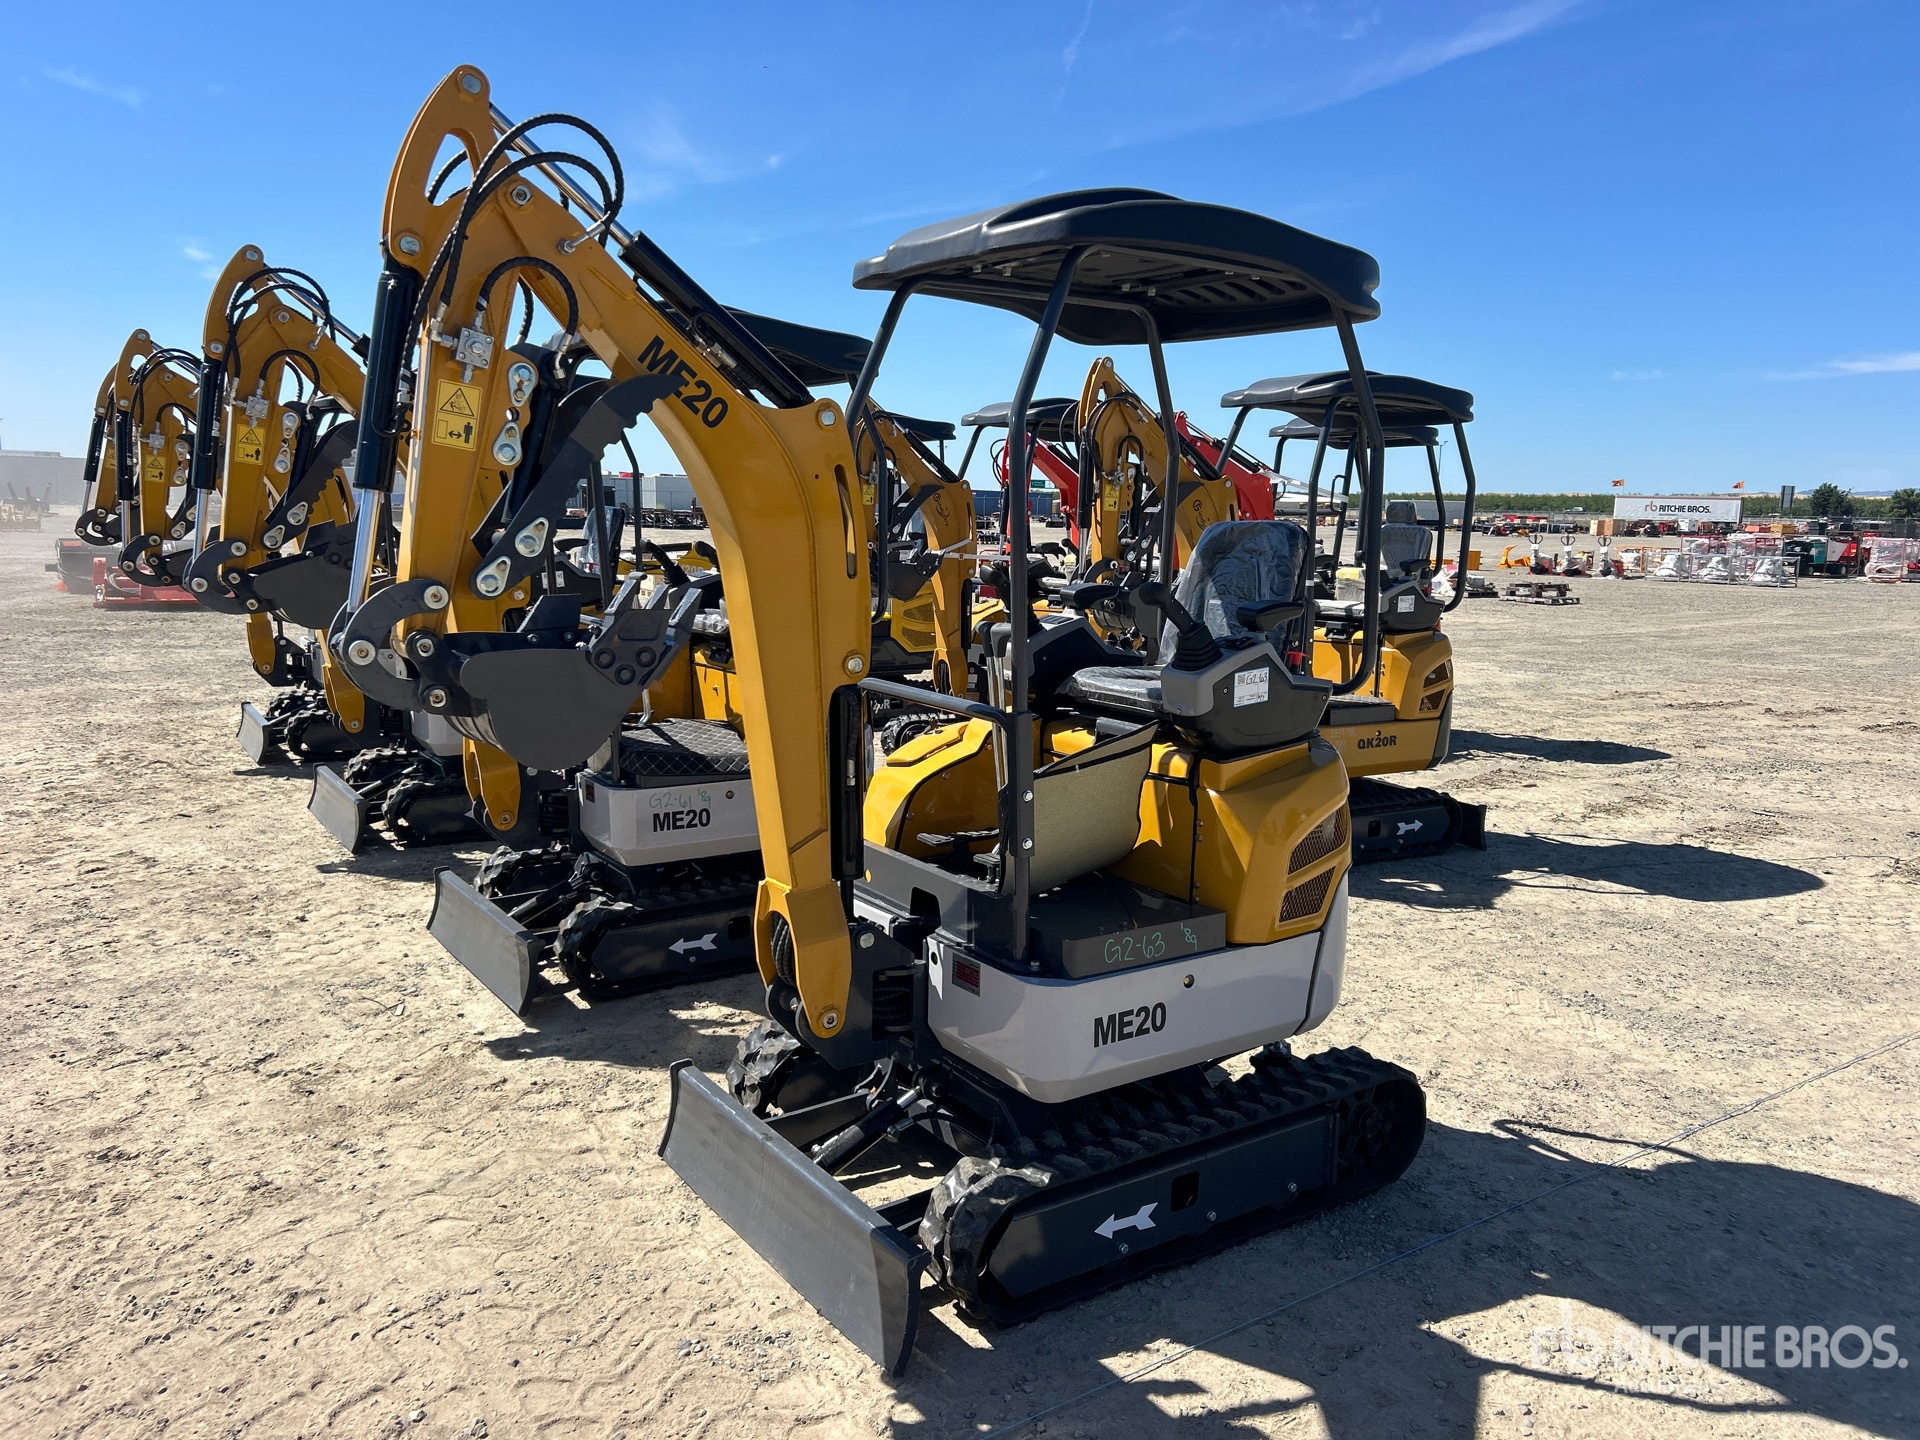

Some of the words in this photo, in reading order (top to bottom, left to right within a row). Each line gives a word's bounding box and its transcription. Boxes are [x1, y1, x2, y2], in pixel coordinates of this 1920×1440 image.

[1659, 504, 1686, 513] RITCHIE
[1687, 505, 1712, 514] BROS.
[1357, 735, 1397, 750] QK20R
[652, 807, 711, 832] ME20
[1104, 931, 1166, 964] G2-63
[1093, 1001, 1167, 1048] ME20
